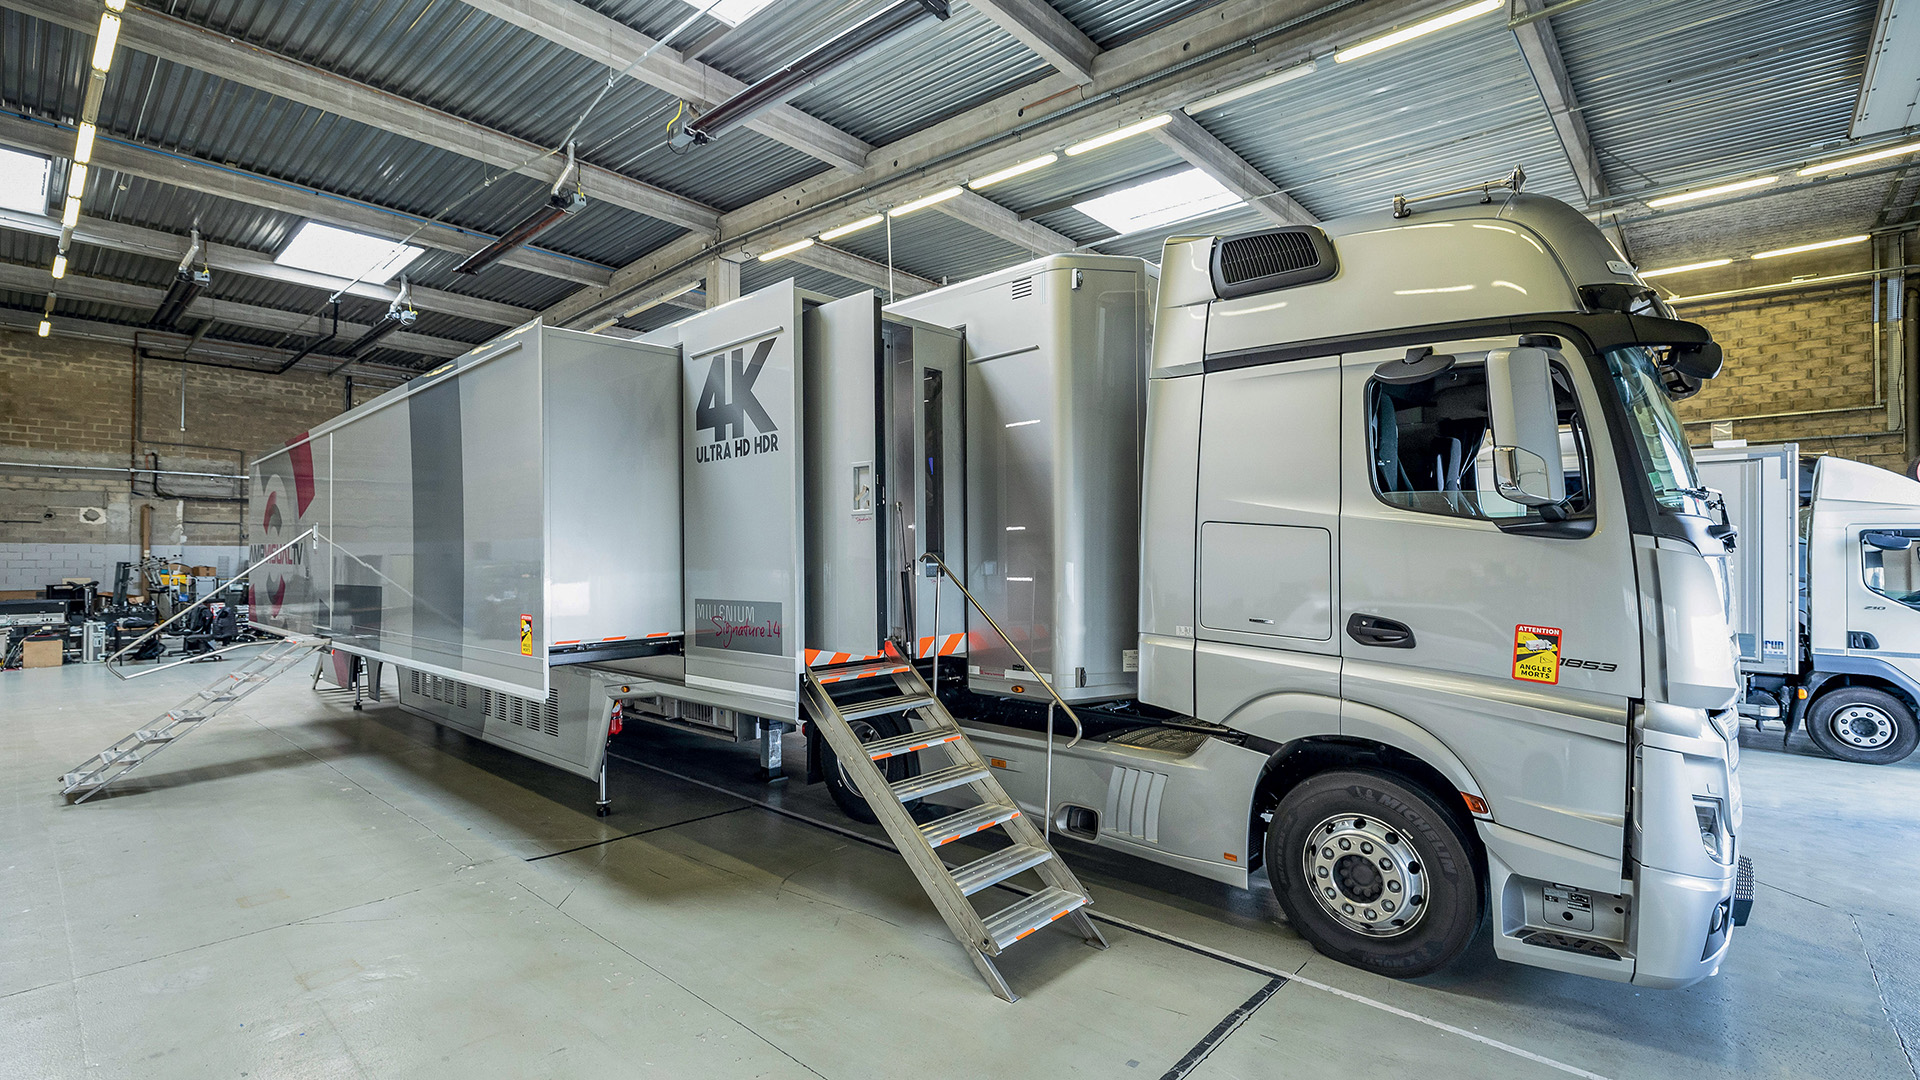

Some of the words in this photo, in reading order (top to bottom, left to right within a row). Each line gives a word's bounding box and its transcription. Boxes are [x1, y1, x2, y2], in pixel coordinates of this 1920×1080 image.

[696, 337, 778, 442] 4K
[696, 442, 732, 464] ULTRA
[734, 438, 750, 458] HD
[754, 433, 779, 455] HDR
[696, 603, 755, 624] MILLENIUM
[711, 615, 766, 648] Signature
[1518, 626, 1559, 635] ATTENTION
[1520, 663, 1552, 673] ANGLES
[1520, 670, 1550, 679] MORTS
[1559, 658, 1617, 672] 1853
[1380, 794, 1457, 875] MICHELIN
